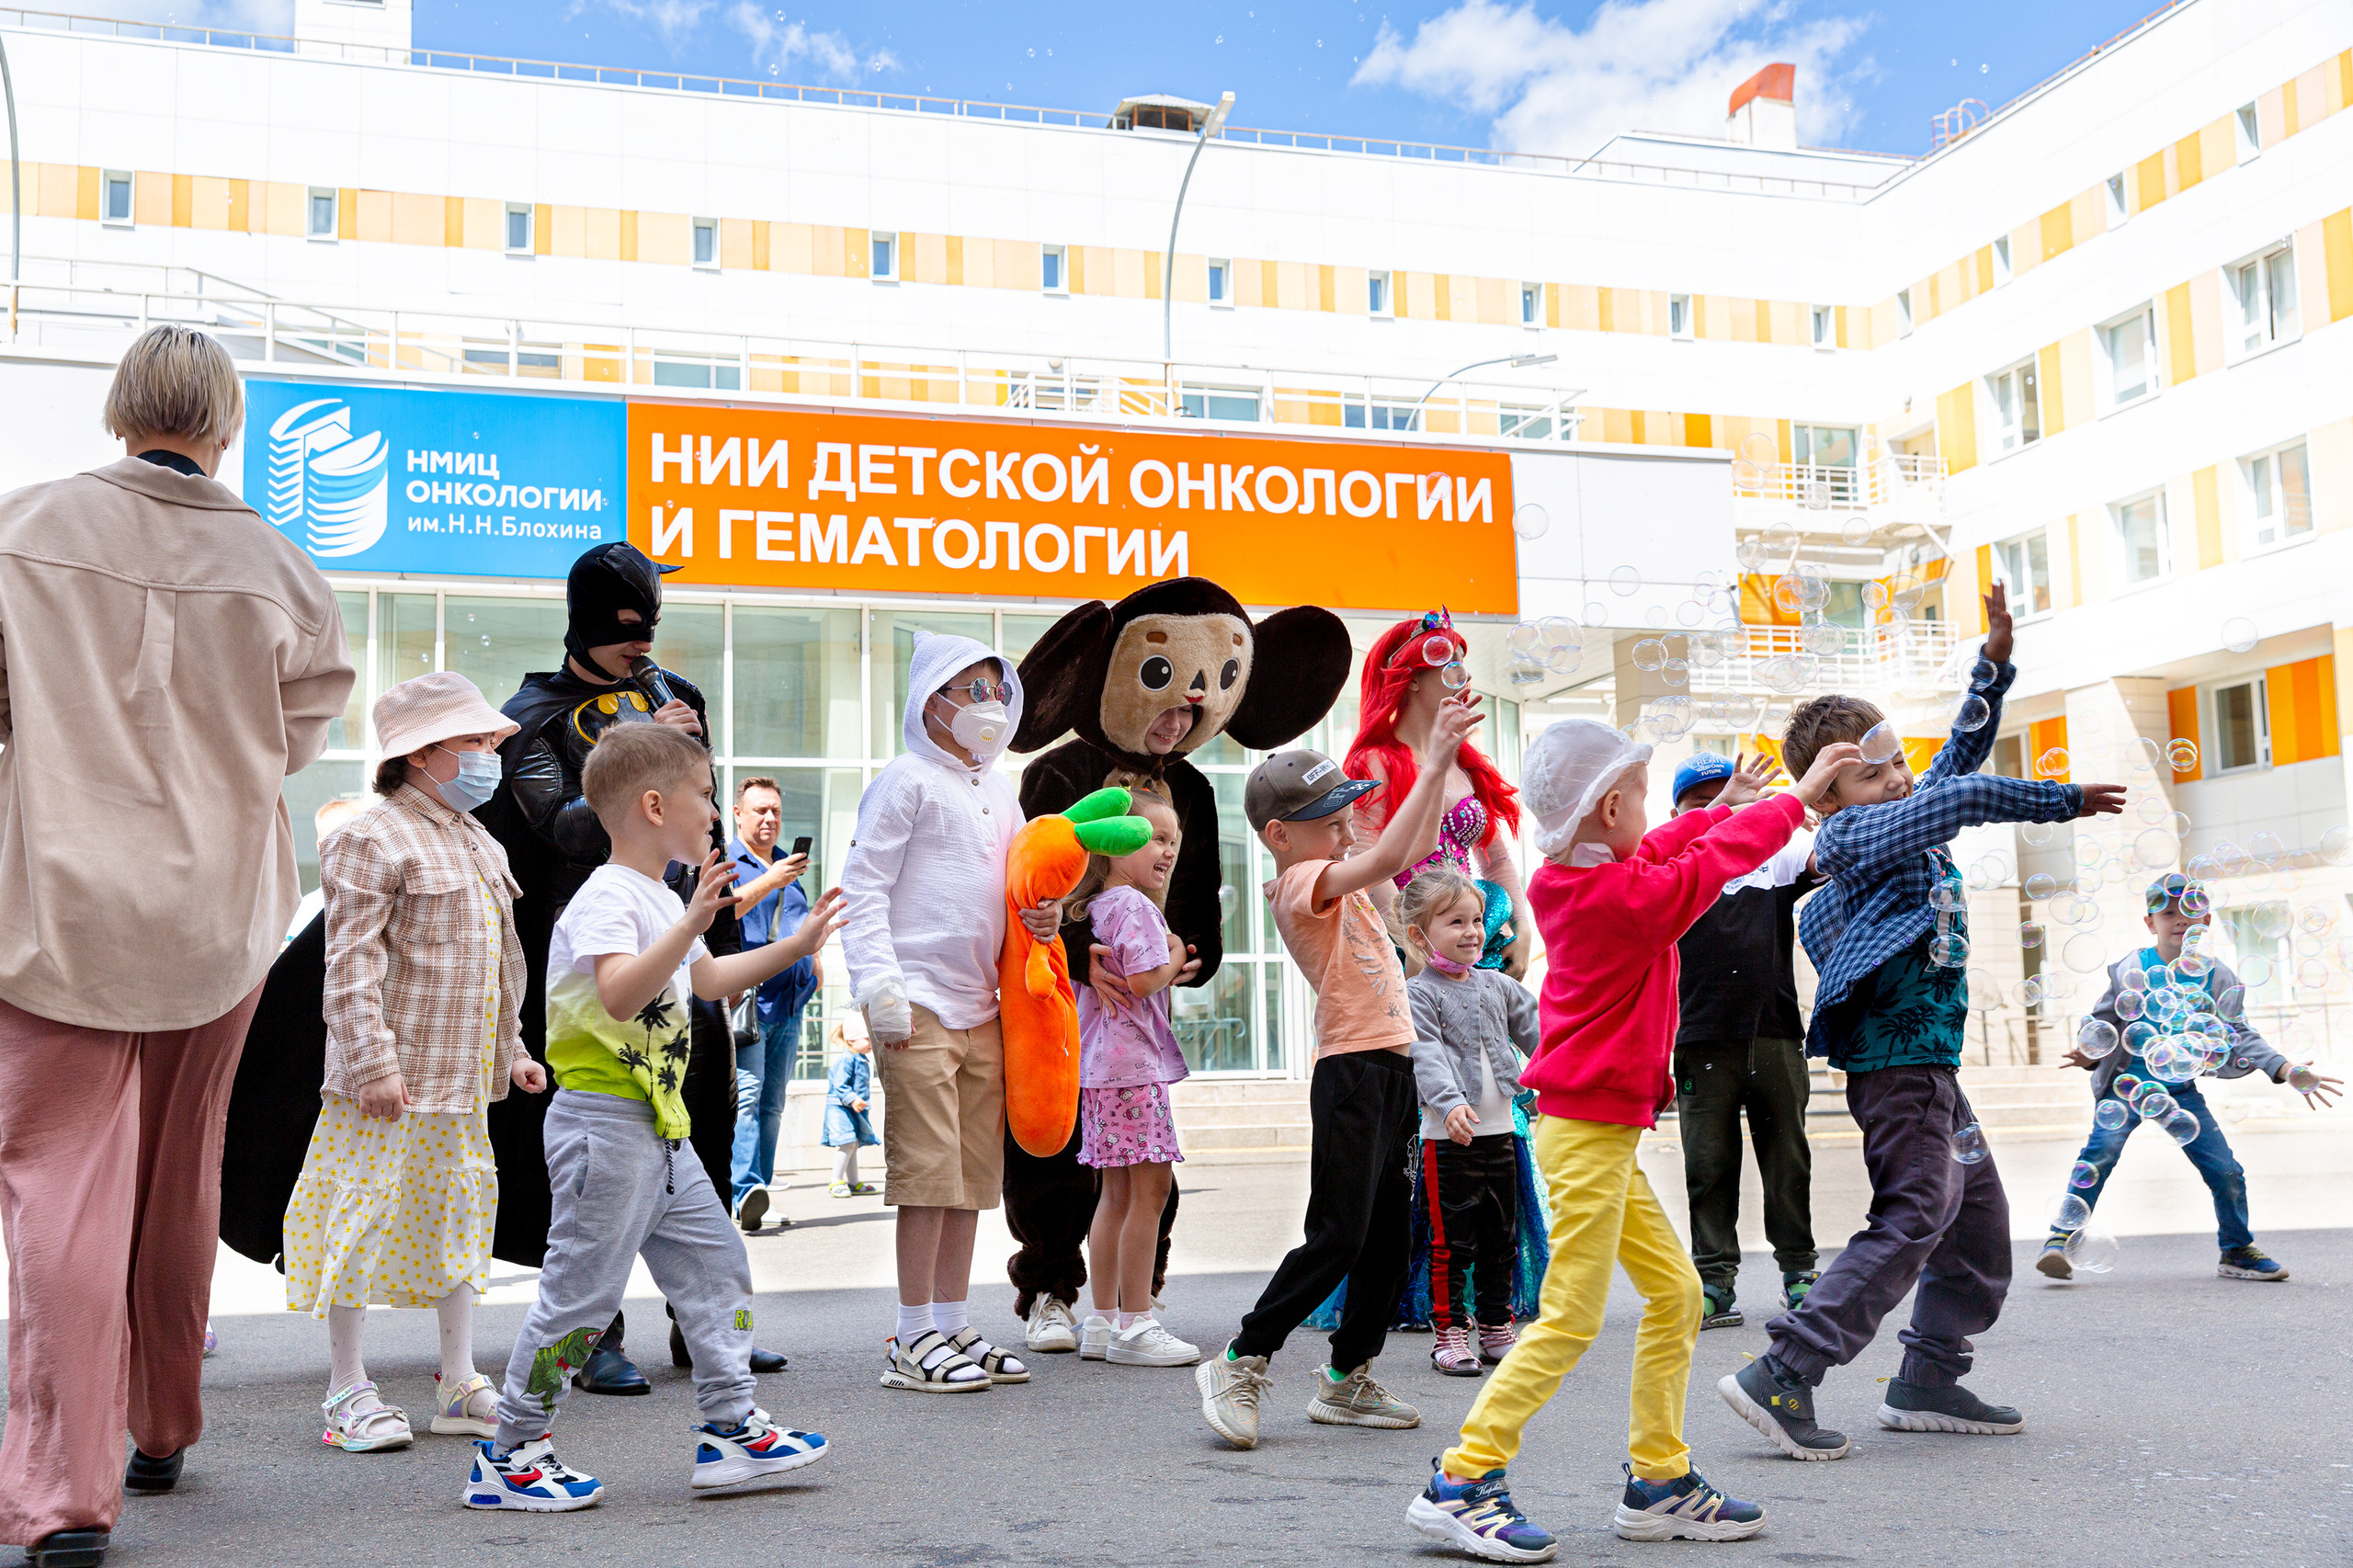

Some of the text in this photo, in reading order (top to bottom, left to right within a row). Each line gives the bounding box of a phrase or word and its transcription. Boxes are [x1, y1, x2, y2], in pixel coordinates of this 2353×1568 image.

[407, 449, 499, 481] НМИЦ
[651, 432, 1494, 523] НИИ ДЕТСКОЙ ОНКОЛОГИИ
[406, 480, 602, 512] ОНКОЛОГИИ
[407, 514, 602, 540] им.Н.Н.Блохина
[651, 506, 1189, 577] И ГЕМАТОЛОГИИ
